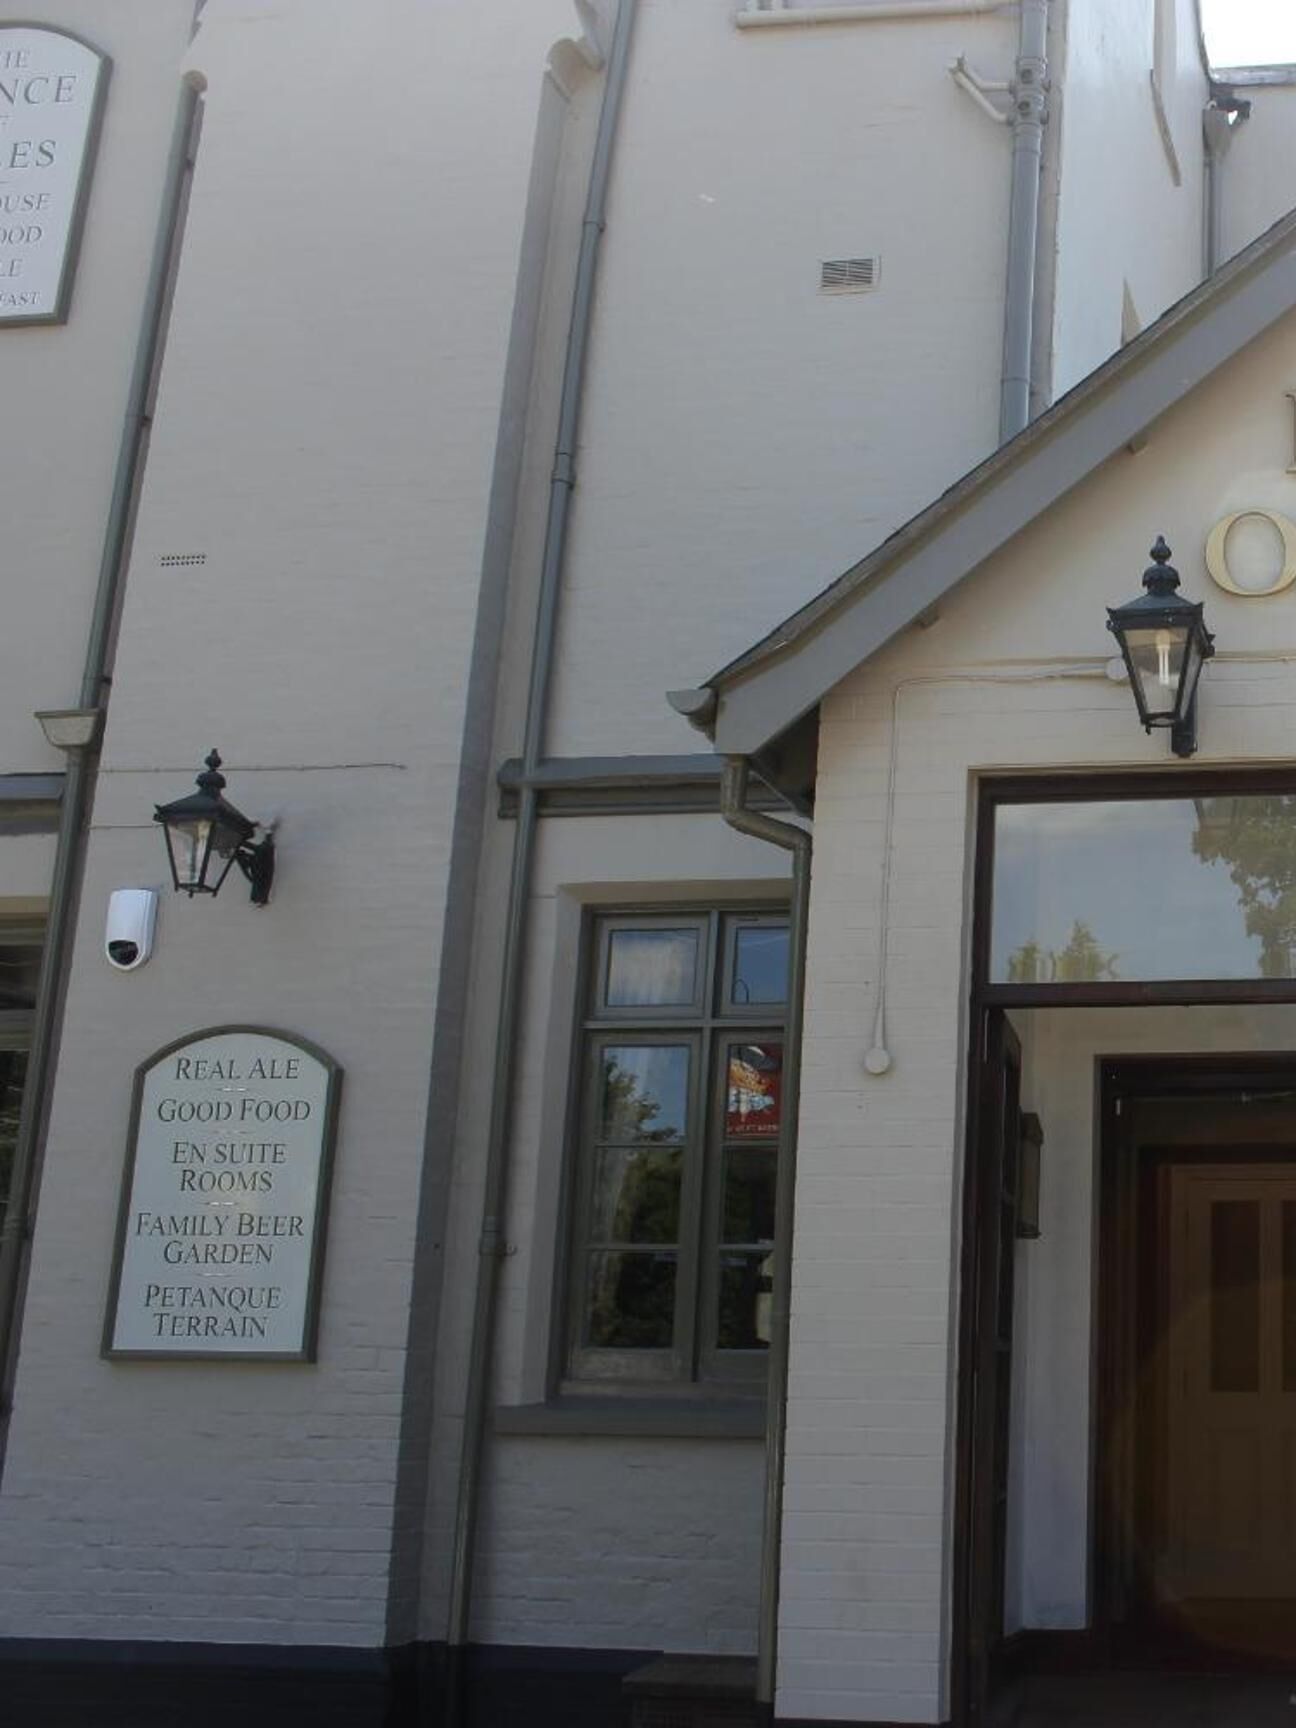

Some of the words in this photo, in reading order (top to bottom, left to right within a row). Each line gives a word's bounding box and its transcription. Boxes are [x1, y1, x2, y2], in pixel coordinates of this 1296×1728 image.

[0, 140, 57, 168] ES
[175, 1058, 241, 1081] REAL
[248, 1058, 301, 1080] ALE
[157, 1099, 232, 1122] GOOD
[240, 1099, 311, 1121] FOOD
[172, 1141, 206, 1164] EN
[213, 1143, 286, 1164] SUITE
[180, 1169, 273, 1193] ROOMS
[135, 1213, 229, 1236] FAMILY
[236, 1213, 305, 1236] BEER
[163, 1240, 273, 1264] GARDEN
[144, 1284, 281, 1311] PETANQUE
[153, 1313, 268, 1338] TERRAIN
